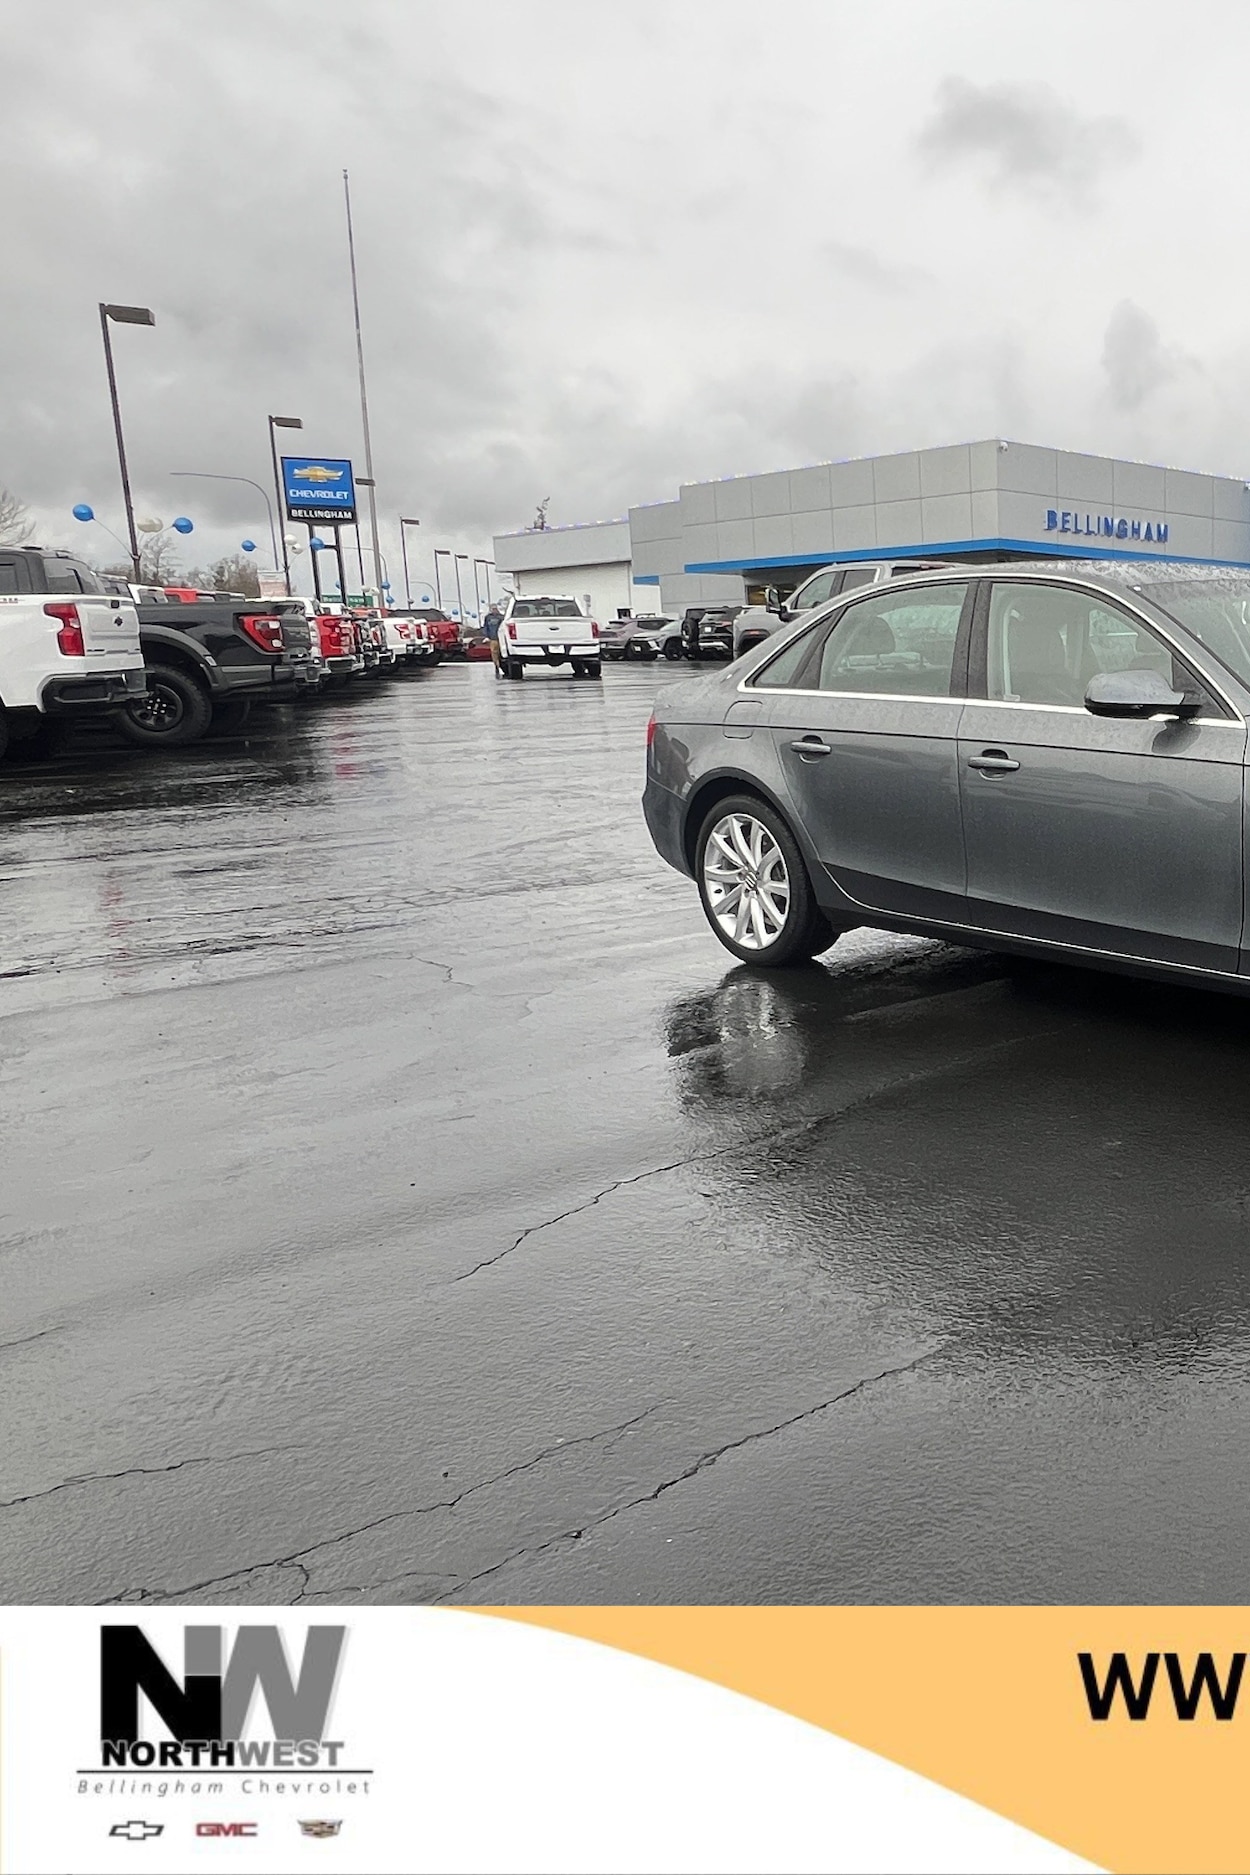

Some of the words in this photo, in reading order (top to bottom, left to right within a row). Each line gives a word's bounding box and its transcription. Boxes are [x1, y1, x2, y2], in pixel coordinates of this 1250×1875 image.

[289, 489, 349, 500] CHEVROLET
[291, 509, 353, 519] BELLINGHAM
[1044, 509, 1169, 544] BELLINGHAM
